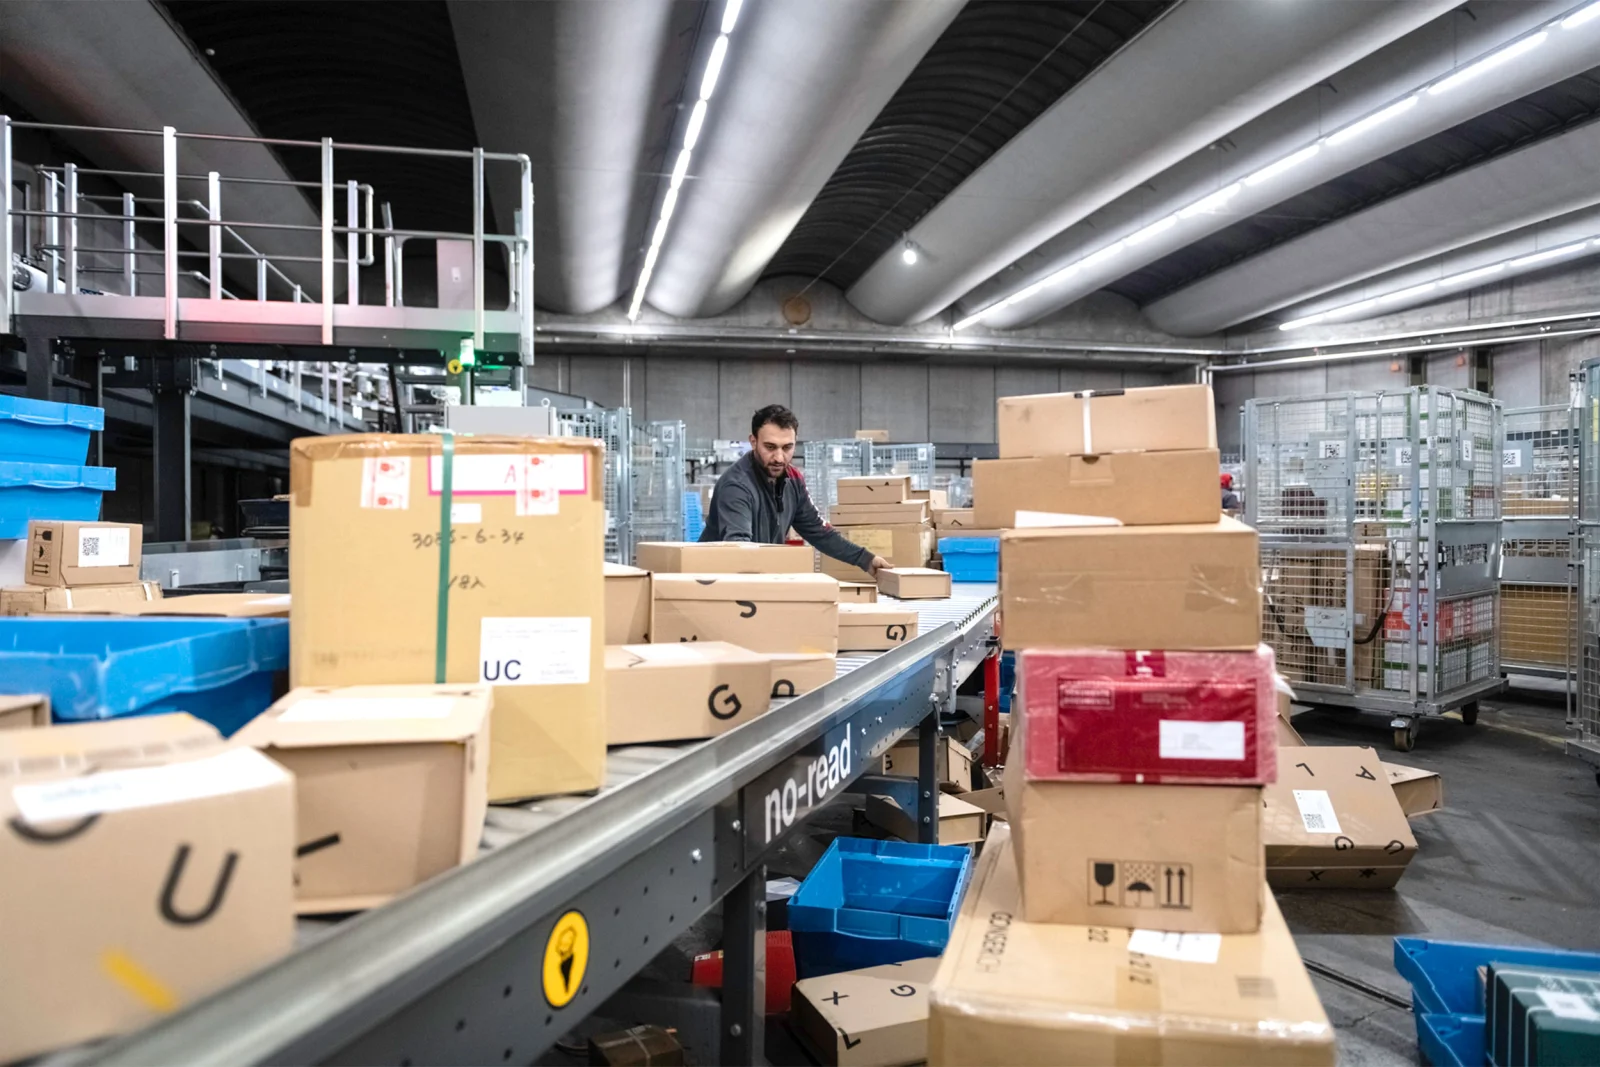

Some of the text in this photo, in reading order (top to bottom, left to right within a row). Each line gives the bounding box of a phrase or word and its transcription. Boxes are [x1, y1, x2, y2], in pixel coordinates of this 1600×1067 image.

[483, 659, 522, 682] UC
[707, 684, 743, 721] G
[765, 722, 851, 844] no-read
[157, 843, 240, 926] U
